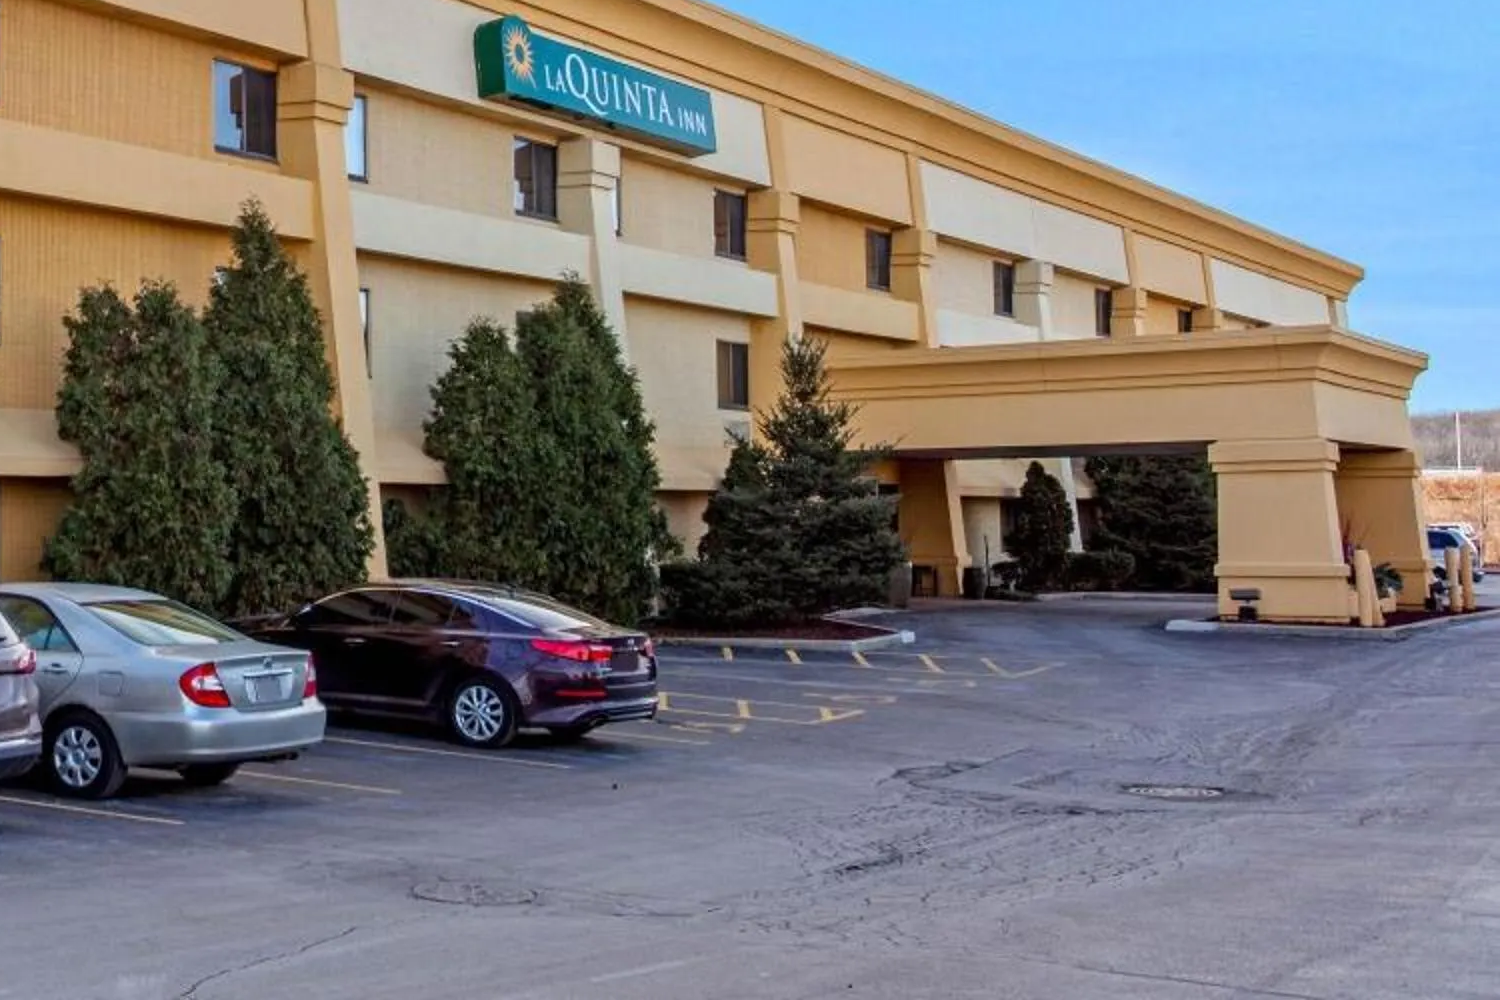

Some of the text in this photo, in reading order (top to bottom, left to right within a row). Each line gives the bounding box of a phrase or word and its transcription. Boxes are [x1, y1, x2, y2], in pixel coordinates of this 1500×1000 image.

[544, 54, 707, 137] LA QUINTA INN
